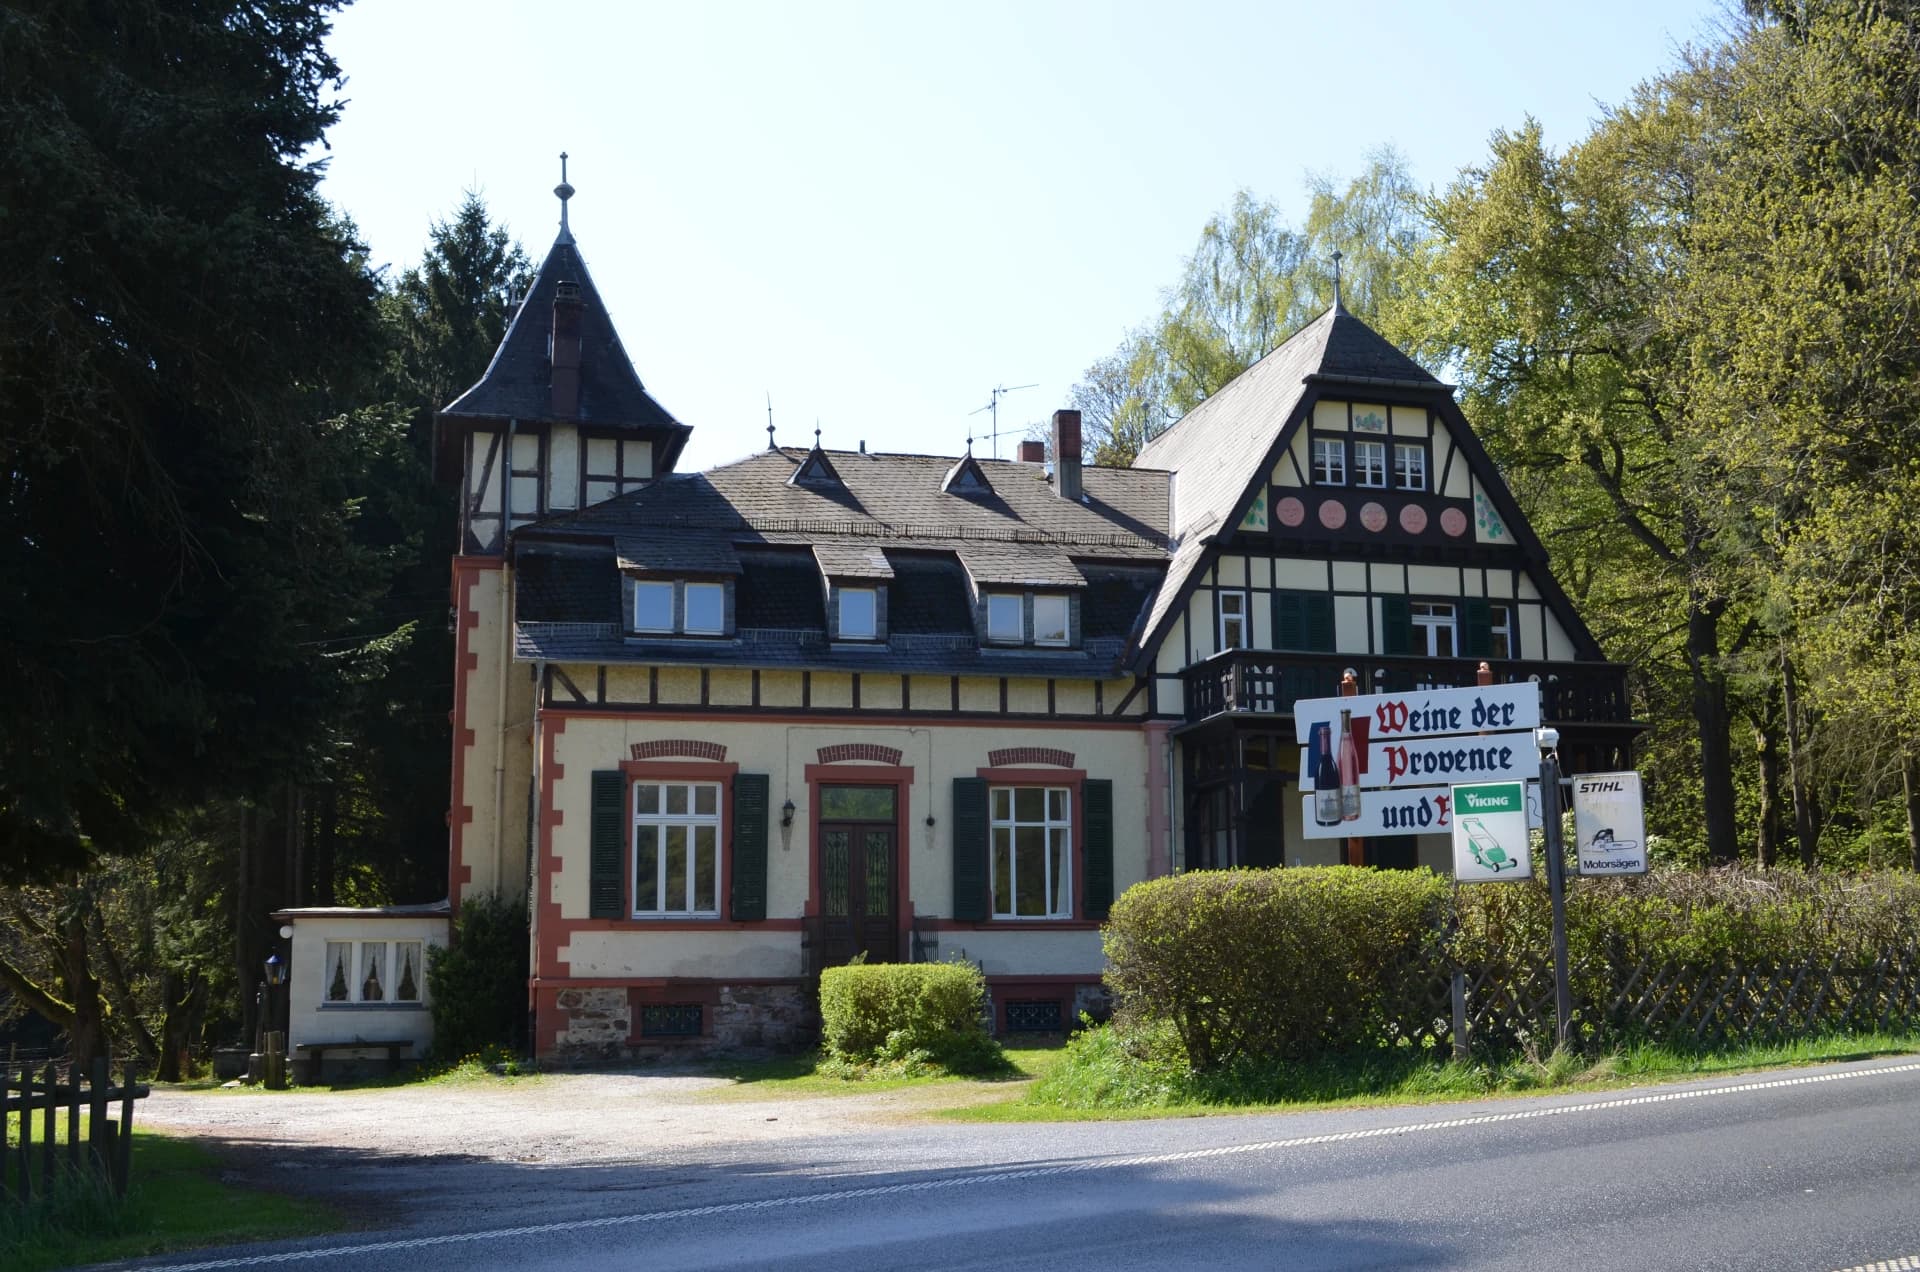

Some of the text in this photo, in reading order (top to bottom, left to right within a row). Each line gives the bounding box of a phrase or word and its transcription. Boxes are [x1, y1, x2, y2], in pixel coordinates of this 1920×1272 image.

[1376, 696, 1515, 734] Weine der
[1382, 745, 1513, 784] Provence
[1579, 782, 1623, 793] STIHL
[1382, 796, 1433, 829] und
[1466, 795, 1510, 808] VIKING
[1583, 858, 1640, 870] Motorsägen
